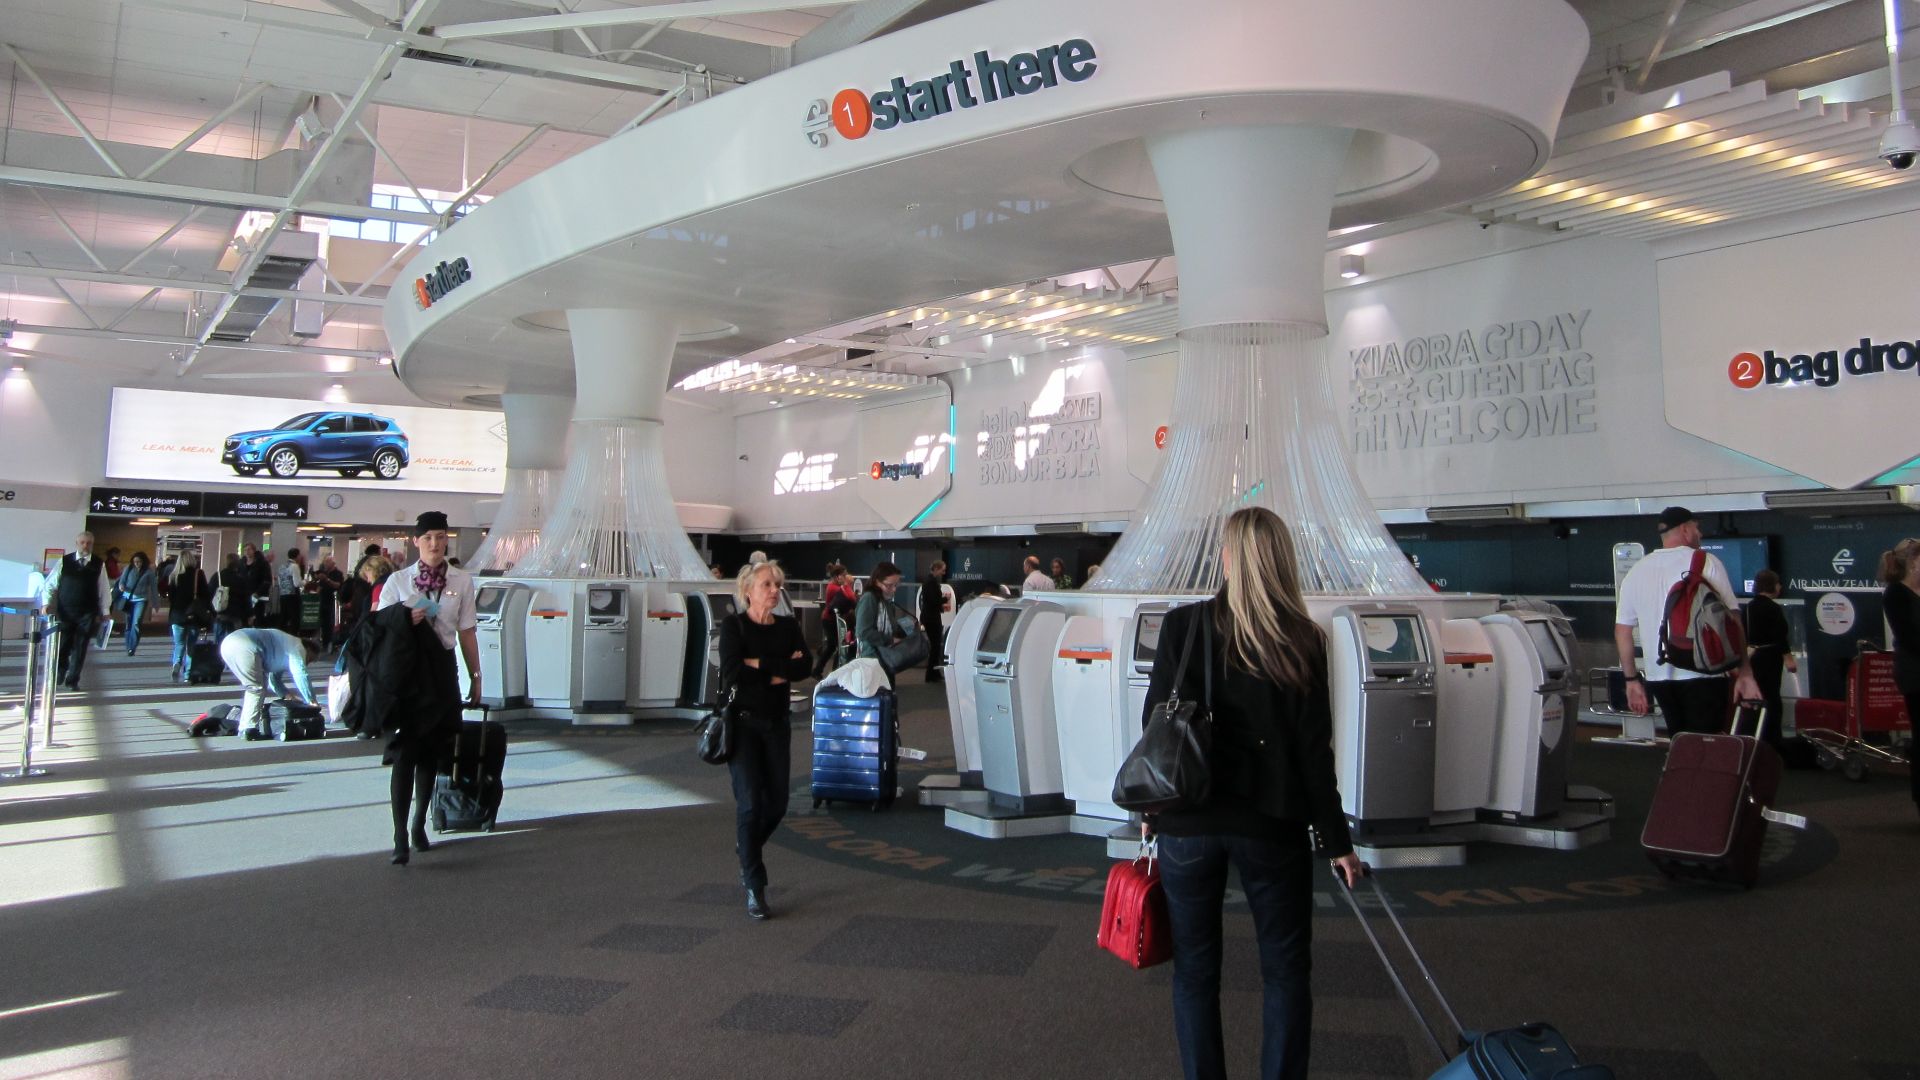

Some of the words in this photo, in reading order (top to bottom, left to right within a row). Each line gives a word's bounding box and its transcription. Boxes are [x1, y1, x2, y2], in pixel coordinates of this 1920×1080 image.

[842, 102, 854, 127] 1
[870, 58, 978, 131] start
[974, 38, 1098, 104] here
[1425, 359, 1524, 404] GUTEN
[1527, 351, 1596, 393] TAG
[1736, 360, 1753, 381] 2
[1763, 350, 1840, 387] bag
[1394, 388, 1598, 450] WELCOME
[1063, 422, 1101, 455] ORA
[415, 457, 437, 465] AND
[439, 458, 475, 466] CLEAN.
[120, 504, 151, 513] Regional
[121, 495, 151, 505] Regional
[152, 497, 190, 506] departures
[237, 502, 257, 510] Gates
[1789, 577, 1808, 590] AIR
[1811, 579, 1841, 588] NEW
[1413, 885, 1584, 908] KIA
